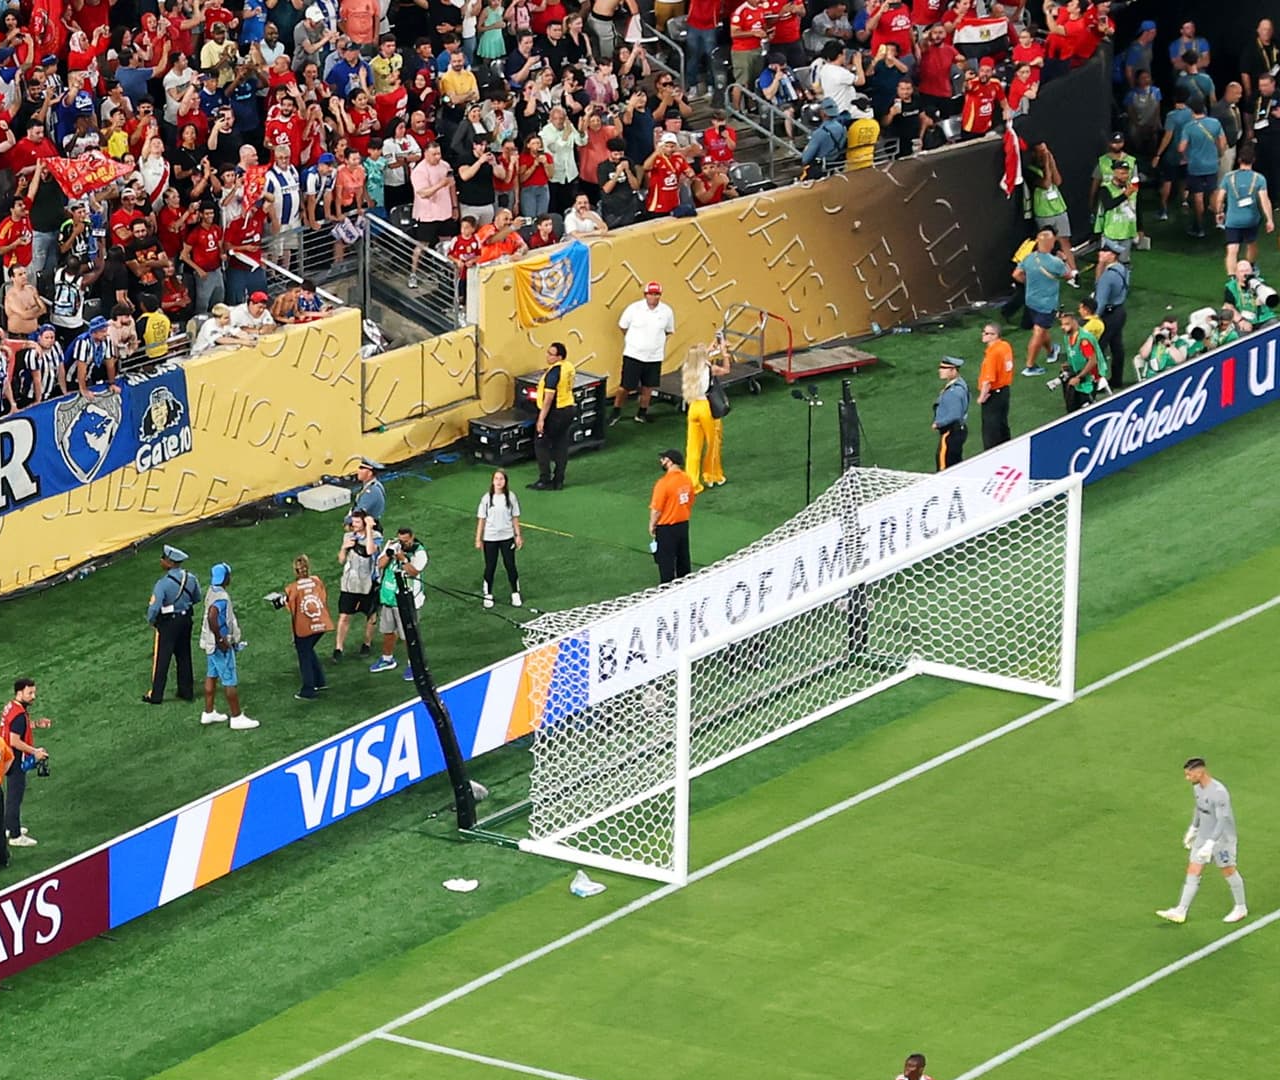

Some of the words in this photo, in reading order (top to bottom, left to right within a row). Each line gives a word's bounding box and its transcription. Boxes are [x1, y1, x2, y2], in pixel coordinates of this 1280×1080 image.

[1068, 366, 1215, 479] Michelob
[597, 595, 710, 684] BANK
[725, 566, 774, 624] OF
[786, 485, 970, 602] AMERICA
[285, 710, 422, 830] VISA
